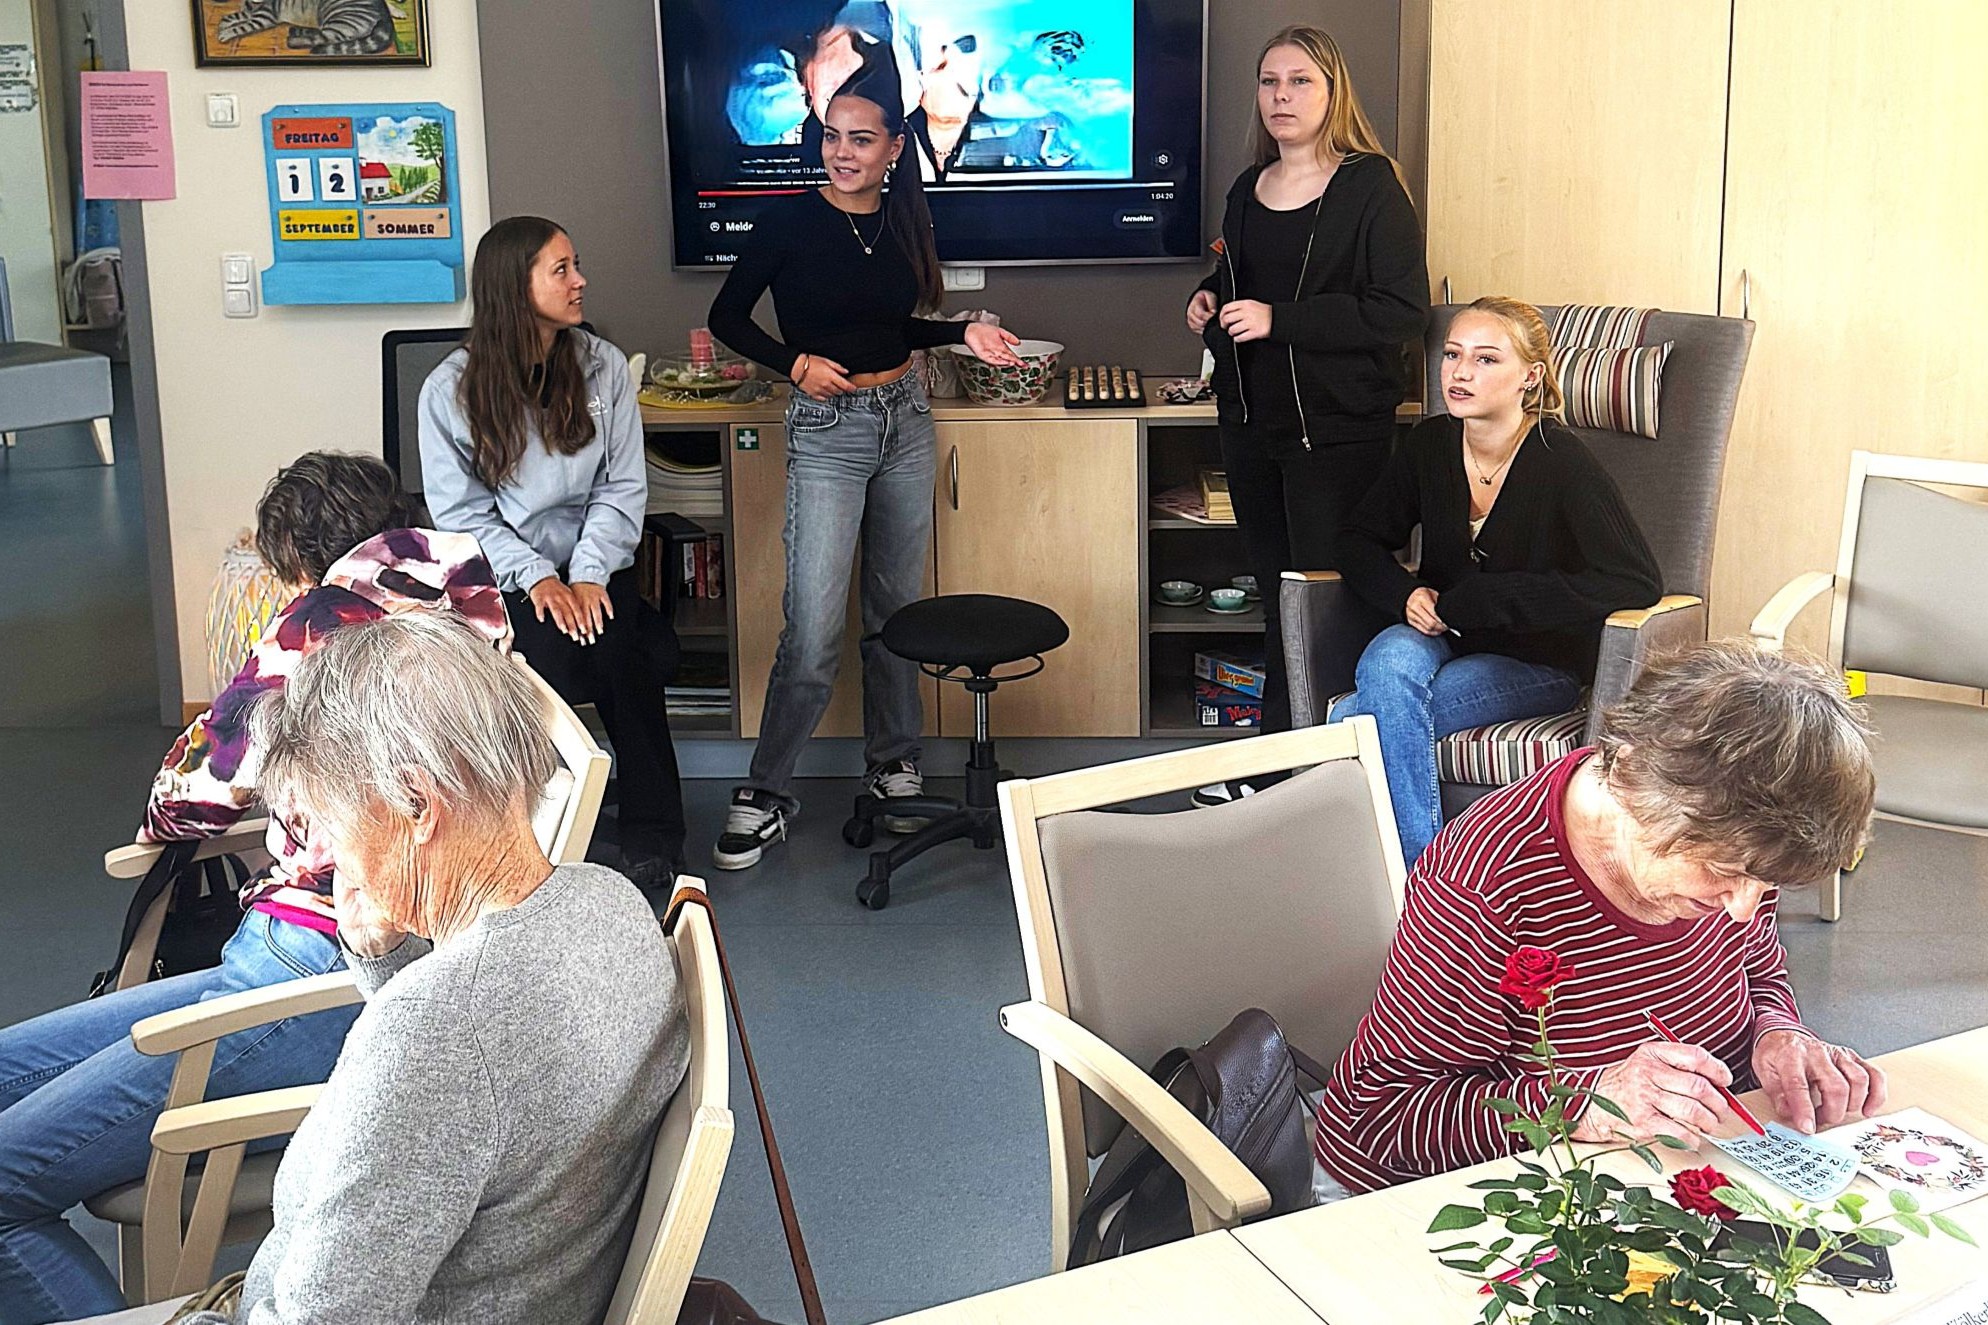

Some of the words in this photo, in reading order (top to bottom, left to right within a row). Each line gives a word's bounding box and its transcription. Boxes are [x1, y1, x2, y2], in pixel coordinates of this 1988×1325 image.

[285, 132, 339, 144] FREITAG
[289, 174, 299, 194] 1
[329, 173, 346, 193] 2
[285, 223, 354, 234] SEPTEMBER
[377, 223, 435, 235] SOMMER
[1829, 1158, 1840, 1166] 2
